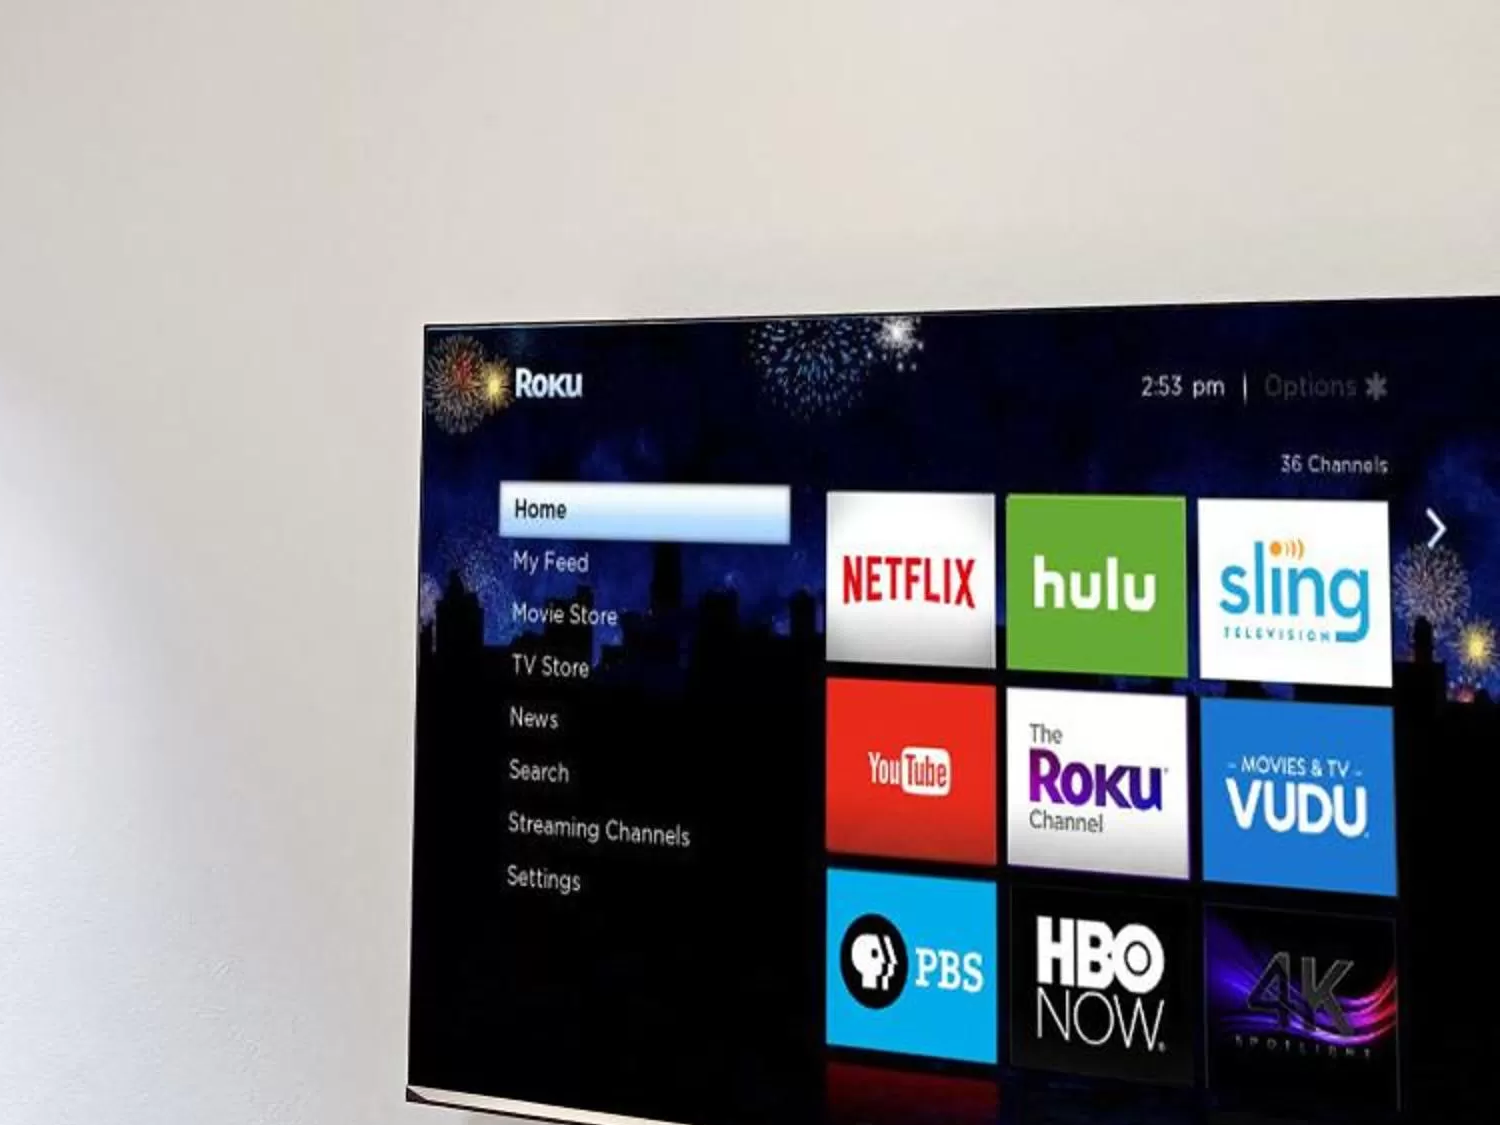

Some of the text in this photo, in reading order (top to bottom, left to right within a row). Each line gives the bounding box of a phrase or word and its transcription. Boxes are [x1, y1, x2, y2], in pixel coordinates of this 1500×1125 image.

[1141, 374, 1225, 399] 2:53 pm
[1264, 373, 1357, 399] Options
[1280, 454, 1389, 474] 36 Channels
[514, 498, 567, 519] Home
[513, 549, 590, 576] My Feed
[842, 555, 976, 609] NETFLIX
[1033, 554, 1157, 612] hulu
[1219, 540, 1370, 643] sling
[512, 601, 618, 627] Movie Store
[1224, 626, 1330, 642] TELEVISION
[512, 653, 590, 679] TV Store
[509, 705, 559, 730] News
[1029, 723, 1063, 744] The
[509, 758, 570, 784] Search
[868, 751, 948, 788] YouTube
[1241, 755, 1350, 778] MOVIES & TV
[1225, 777, 1368, 838] VUDU
[508, 810, 691, 848] Streaming Channels
[1029, 809, 1104, 833] Channel
[507, 864, 581, 895] Settings
[1037, 915, 1165, 994] HBO
[915, 947, 984, 993] PBS
[1247, 951, 1355, 1037] 4K
